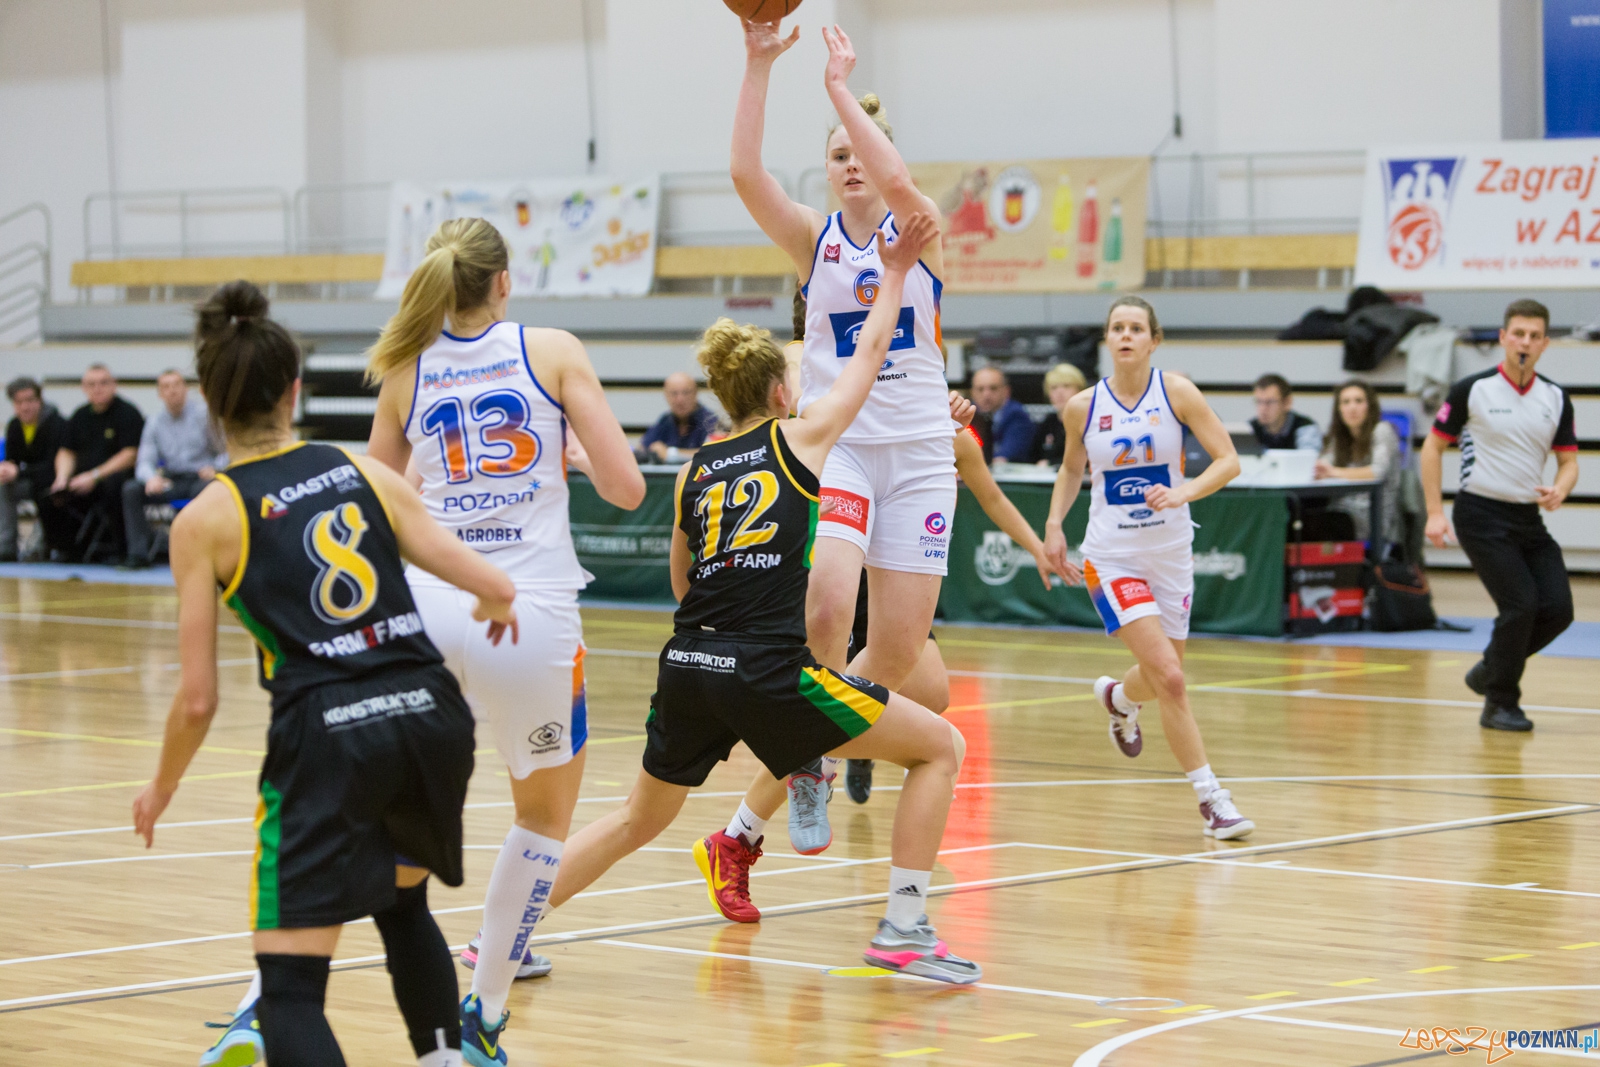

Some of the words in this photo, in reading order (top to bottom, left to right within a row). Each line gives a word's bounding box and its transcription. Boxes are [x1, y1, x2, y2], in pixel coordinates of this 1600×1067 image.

[1476, 157, 1598, 201] Zagraj
[1516, 219, 1547, 243] w
[853, 268, 881, 307] 6
[423, 359, 519, 390] PŁÓCIENNIK
[877, 373, 907, 382] Motors
[421, 388, 542, 484] 13
[1111, 433, 1156, 466] 21
[712, 446, 767, 470] GASTER
[280, 464, 359, 502] GASTER
[694, 470, 780, 562] 12
[456, 528, 523, 543] AGROBEX
[303, 501, 378, 625] 8
[308, 612, 425, 658] FARM2FARM
[322, 688, 435, 726] KONSTRUKTOR
